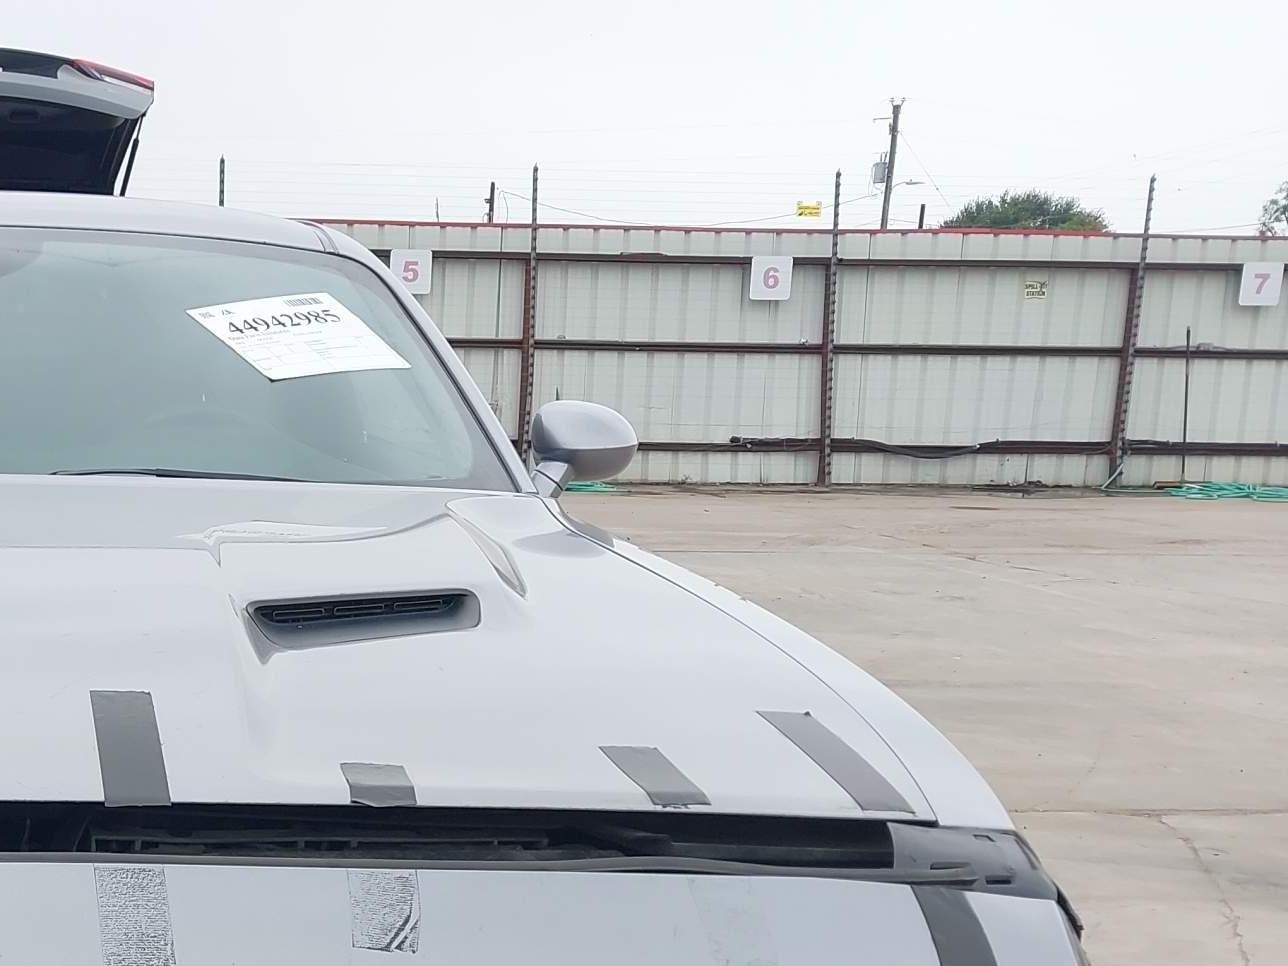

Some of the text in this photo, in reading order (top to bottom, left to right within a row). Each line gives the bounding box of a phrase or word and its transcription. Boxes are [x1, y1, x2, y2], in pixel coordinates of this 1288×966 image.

[401, 260, 419, 283] 5
[761, 267, 779, 289] 6
[1253, 273, 1270, 296] 7
[228, 309, 341, 334] 44942985
